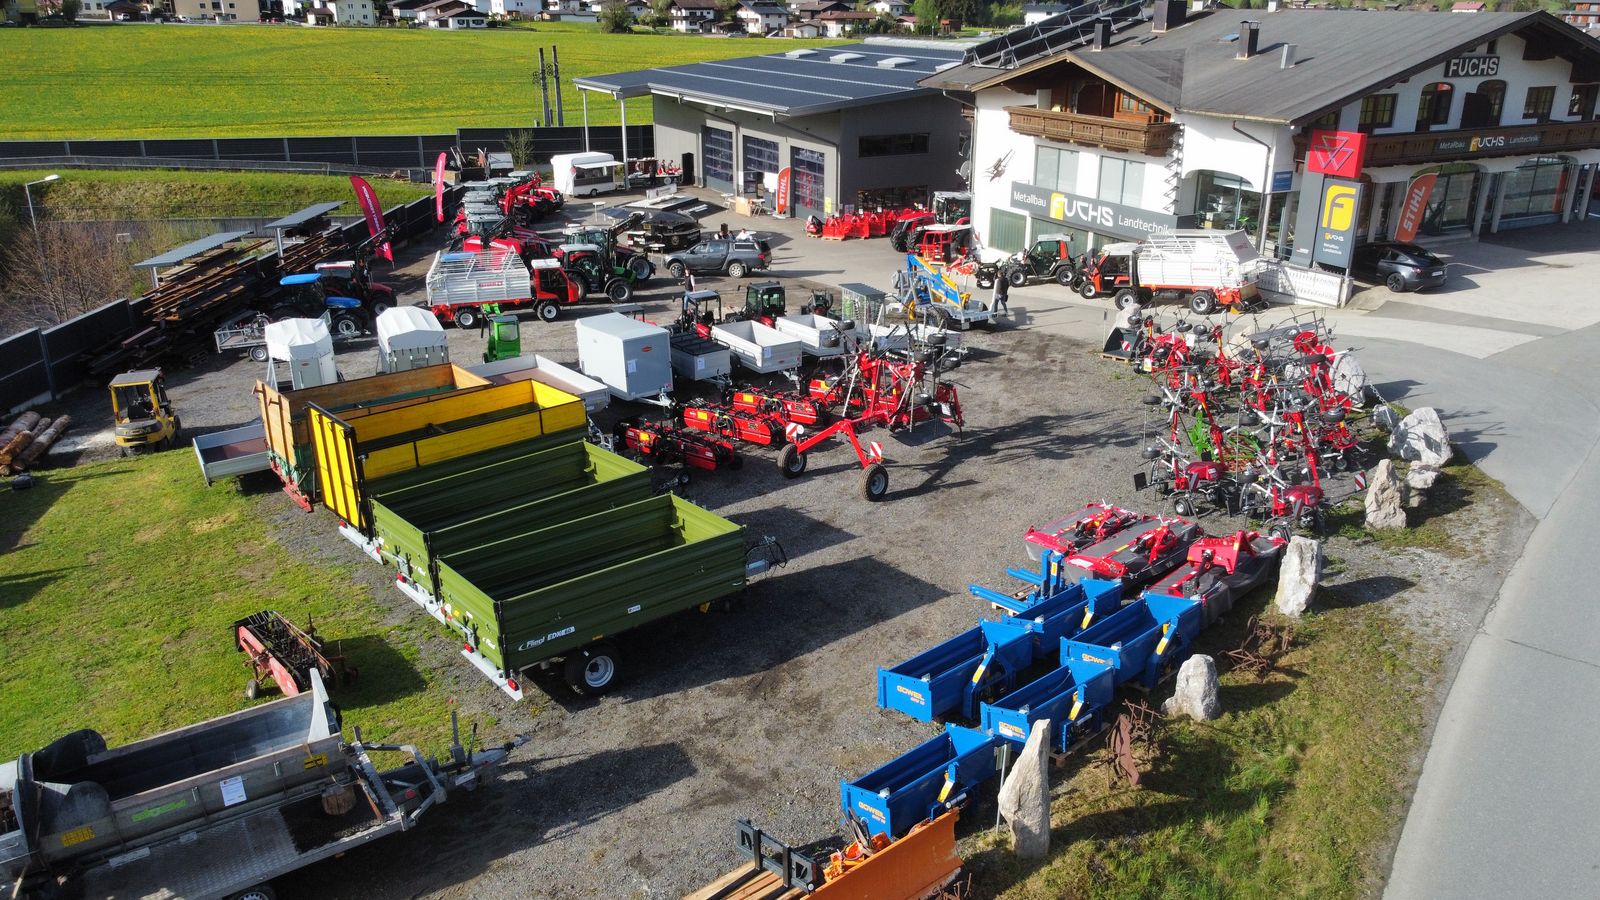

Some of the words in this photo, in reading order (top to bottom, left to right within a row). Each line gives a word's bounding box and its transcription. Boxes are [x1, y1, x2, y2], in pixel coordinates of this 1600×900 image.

[1448, 58, 1499, 77] FUCHS
[1439, 141, 1465, 150] Metallbau
[1469, 136, 1505, 152] FUCHS
[1509, 135, 1540, 145] Landtechnik
[779, 176, 788, 206] STIHL
[1013, 191, 1047, 207] Metallbau
[1051, 193, 1114, 227] FUCHS
[1403, 186, 1426, 232] STIHL
